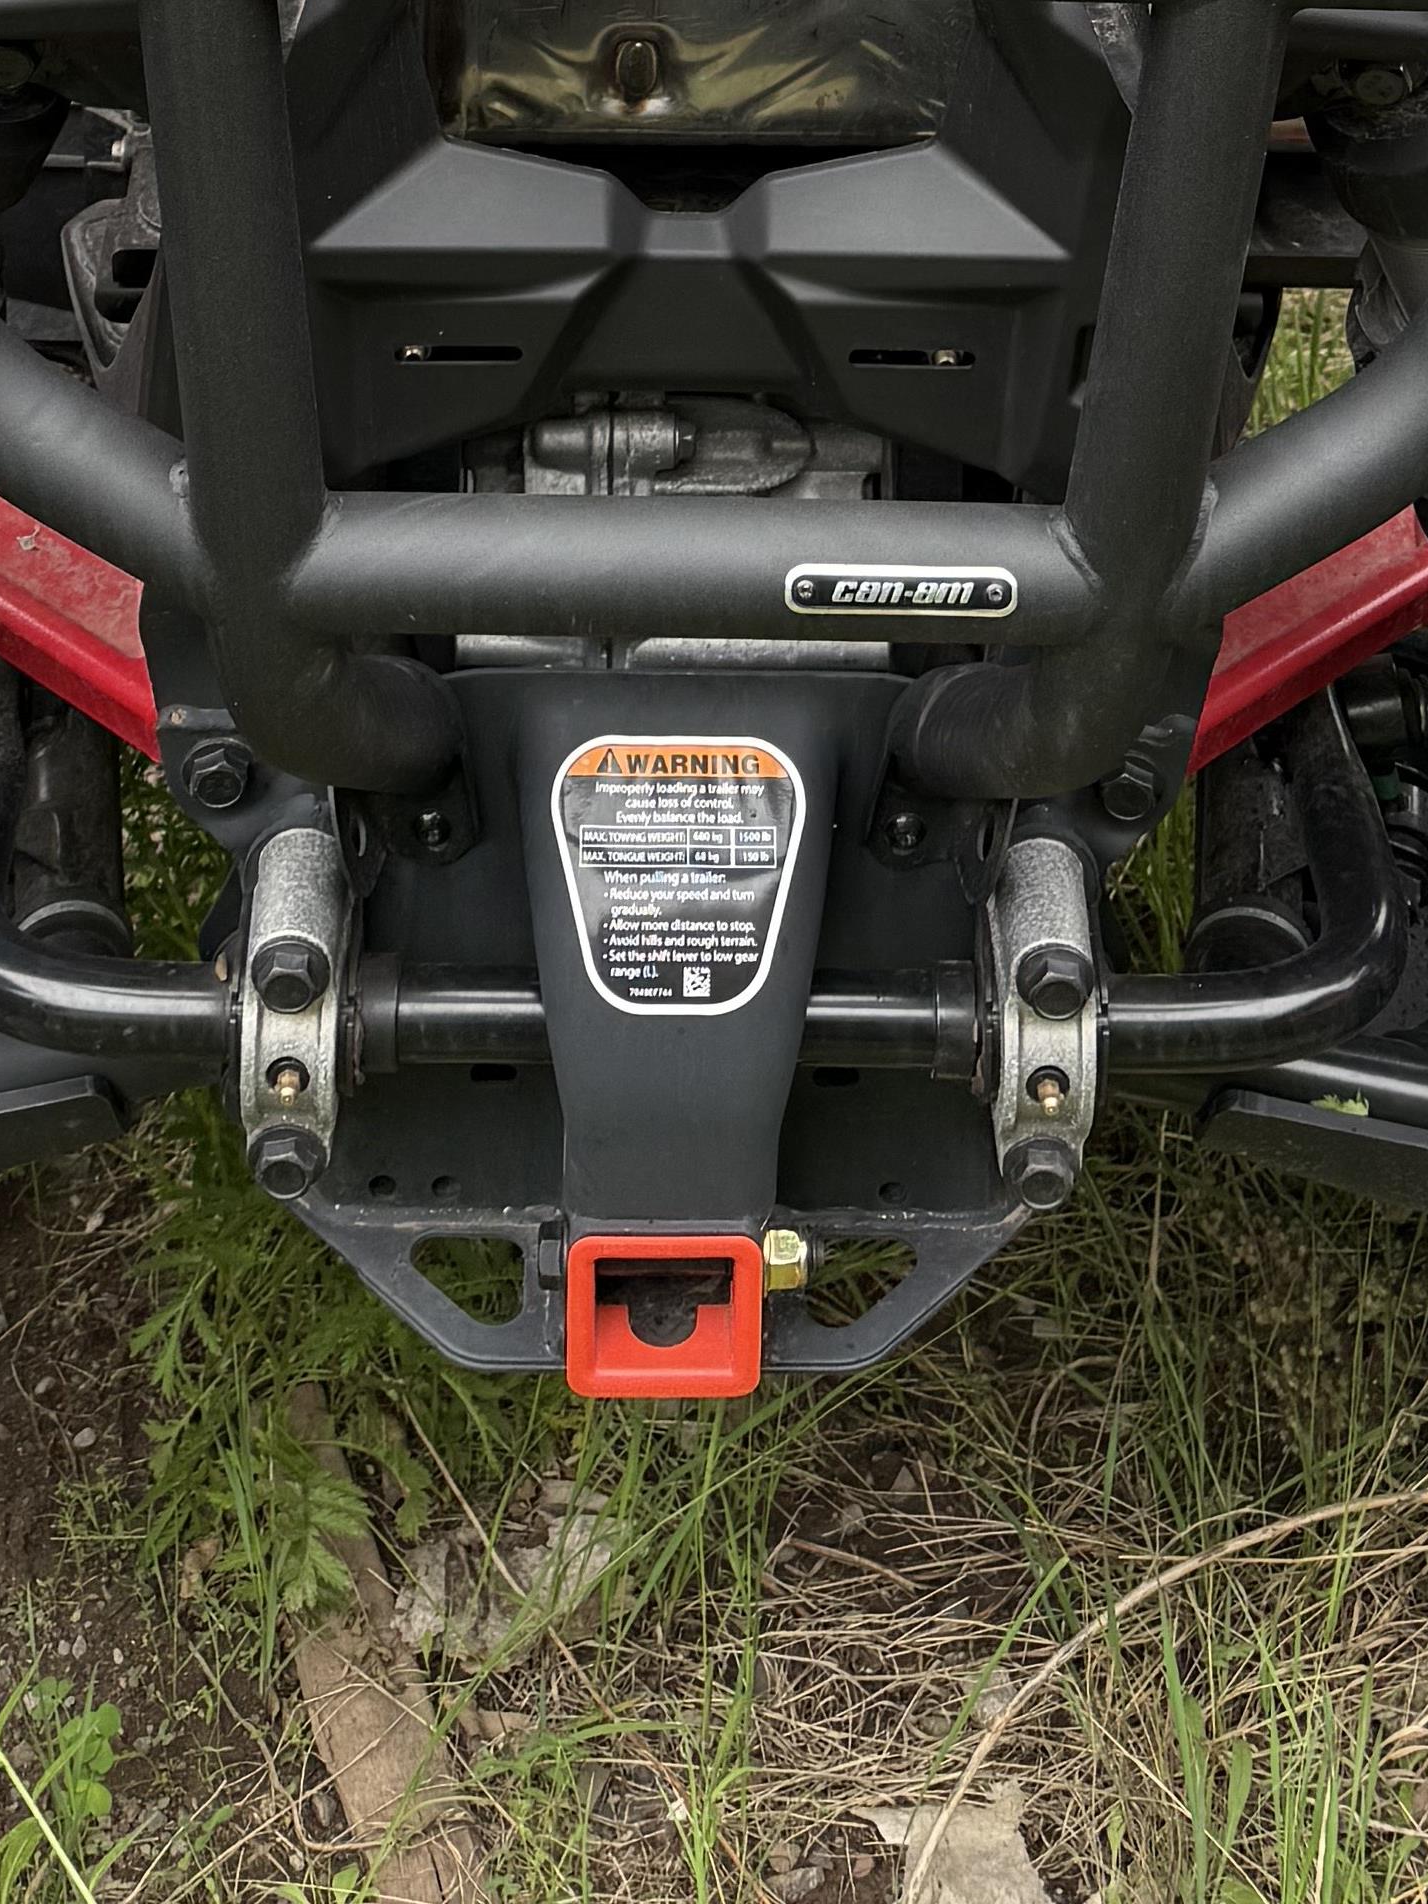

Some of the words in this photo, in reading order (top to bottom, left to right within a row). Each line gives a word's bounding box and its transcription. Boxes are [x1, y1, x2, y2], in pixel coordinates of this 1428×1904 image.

[831, 580, 974, 604] can-am
[626, 754, 760, 775] WARNING
[595, 781, 655, 796] Improperly
[656, 781, 698, 796] loading
[699, 785, 706, 794] a
[708, 782, 739, 794] trailer
[740, 784, 764, 797] may
[625, 799, 656, 808] cause
[658, 797, 679, 808] loss
[680, 797, 692, 808] of
[694, 797, 734, 809] control.
[616, 811, 651, 826] Evenly
[653, 811, 695, 824] balance
[697, 811, 716, 824] the
[717, 812, 744, 824] load.
[608, 831, 646, 842] TOWING
[738, 830, 761, 842] 1500
[761, 830, 772, 842] lb
[583, 851, 606, 862] MAX.
[607, 851, 646, 862] TONGUE
[742, 851, 760, 862] 150
[760, 851, 770, 861] lb
[604, 870, 637, 883] When
[640, 871, 679, 887] pulling
[681, 874, 689, 883] a
[690, 871, 726, 884] trailer:
[609, 888, 649, 900] Reduce
[651, 890, 675, 903] your
[676, 888, 708, 903] speed
[710, 888, 730, 900] and
[732, 889, 755, 901] turn
[611, 904, 662, 918] gradually.
[609, 919, 640, 931] Allow
[641, 922, 668, 931] more
[670, 919, 714, 931] distance
[716, 920, 727, 931] to
[729, 921, 756, 934] stop.
[609, 934, 640, 946] Avoid
[642, 934, 663, 946] hills
[664, 934, 685, 946] and
[687, 934, 718, 949] rough
[720, 936, 757, 947] terrain.
[609, 949, 626, 962] Set
[628, 950, 646, 962] the
[647, 950, 671, 962] shift
[673, 950, 699, 962] lever
[700, 950, 712, 962] to
[713, 950, 732, 962] low
[734, 952, 759, 965] gear
[610, 967, 640, 980] range
